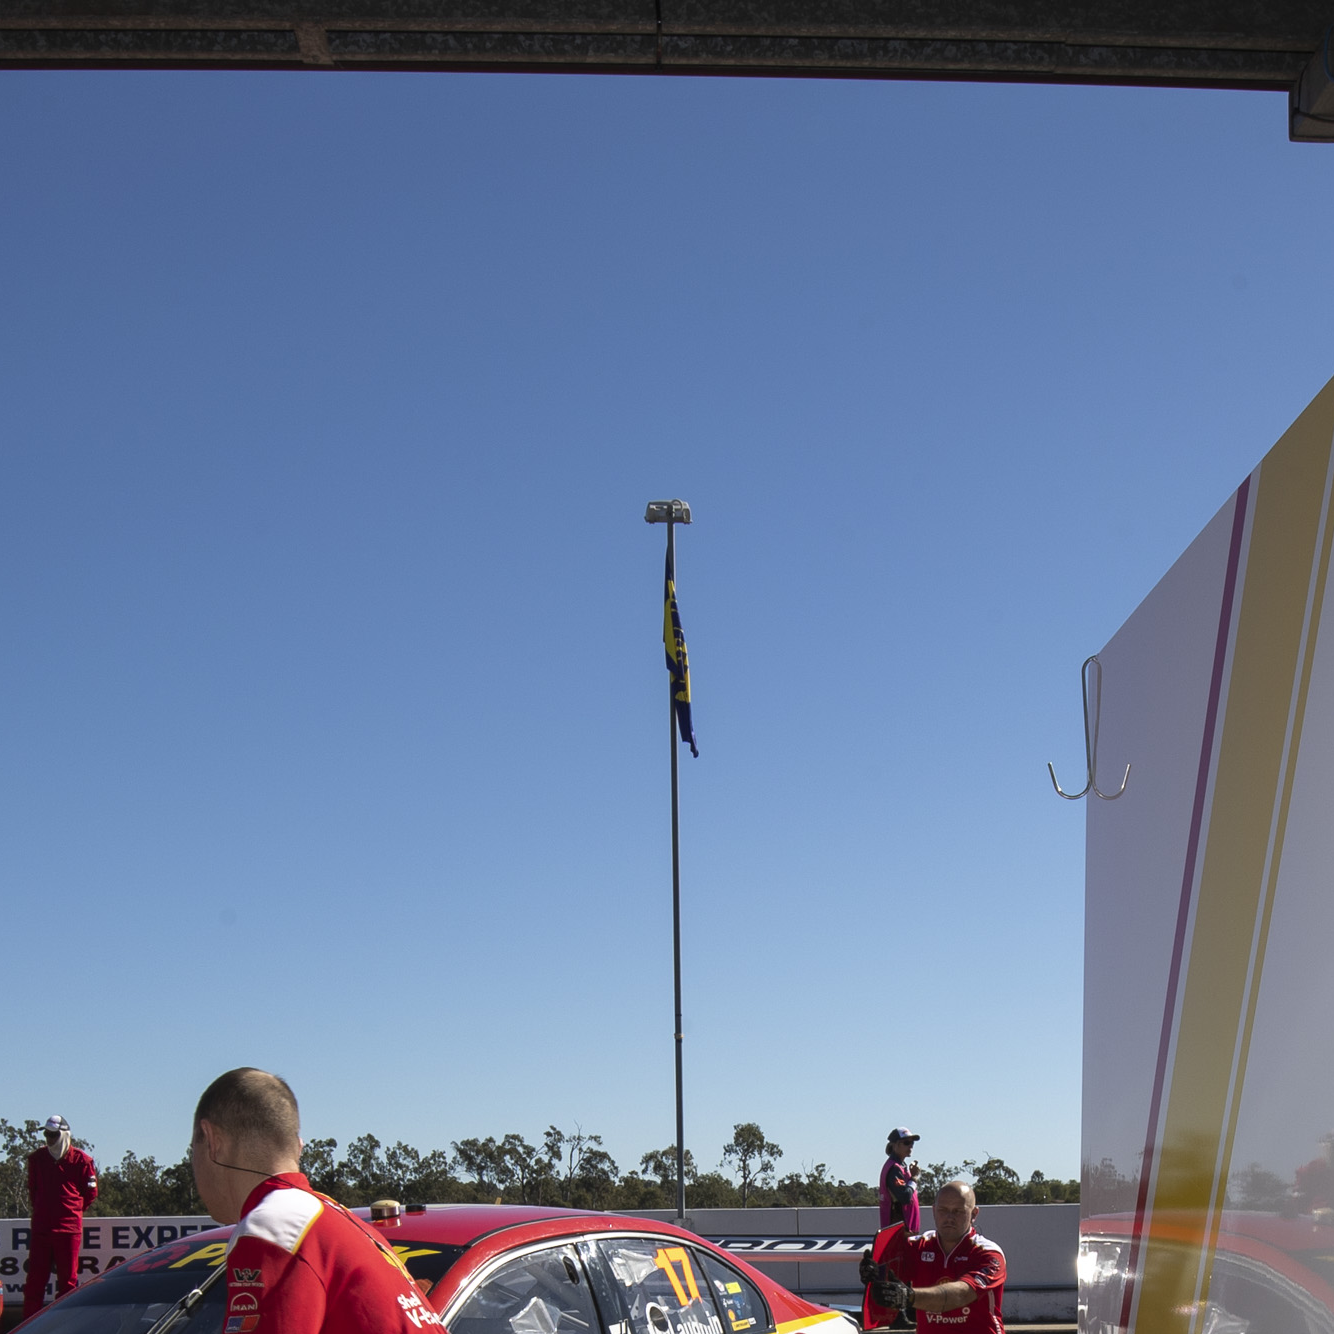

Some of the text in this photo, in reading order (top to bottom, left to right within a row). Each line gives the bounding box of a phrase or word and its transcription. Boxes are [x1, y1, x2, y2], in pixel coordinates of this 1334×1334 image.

[12, 1227, 101, 1250] RE
[112, 1225, 221, 1249] EXP
[654, 1247, 703, 1307] 17
[927, 1315, 968, 1324] V-Power
